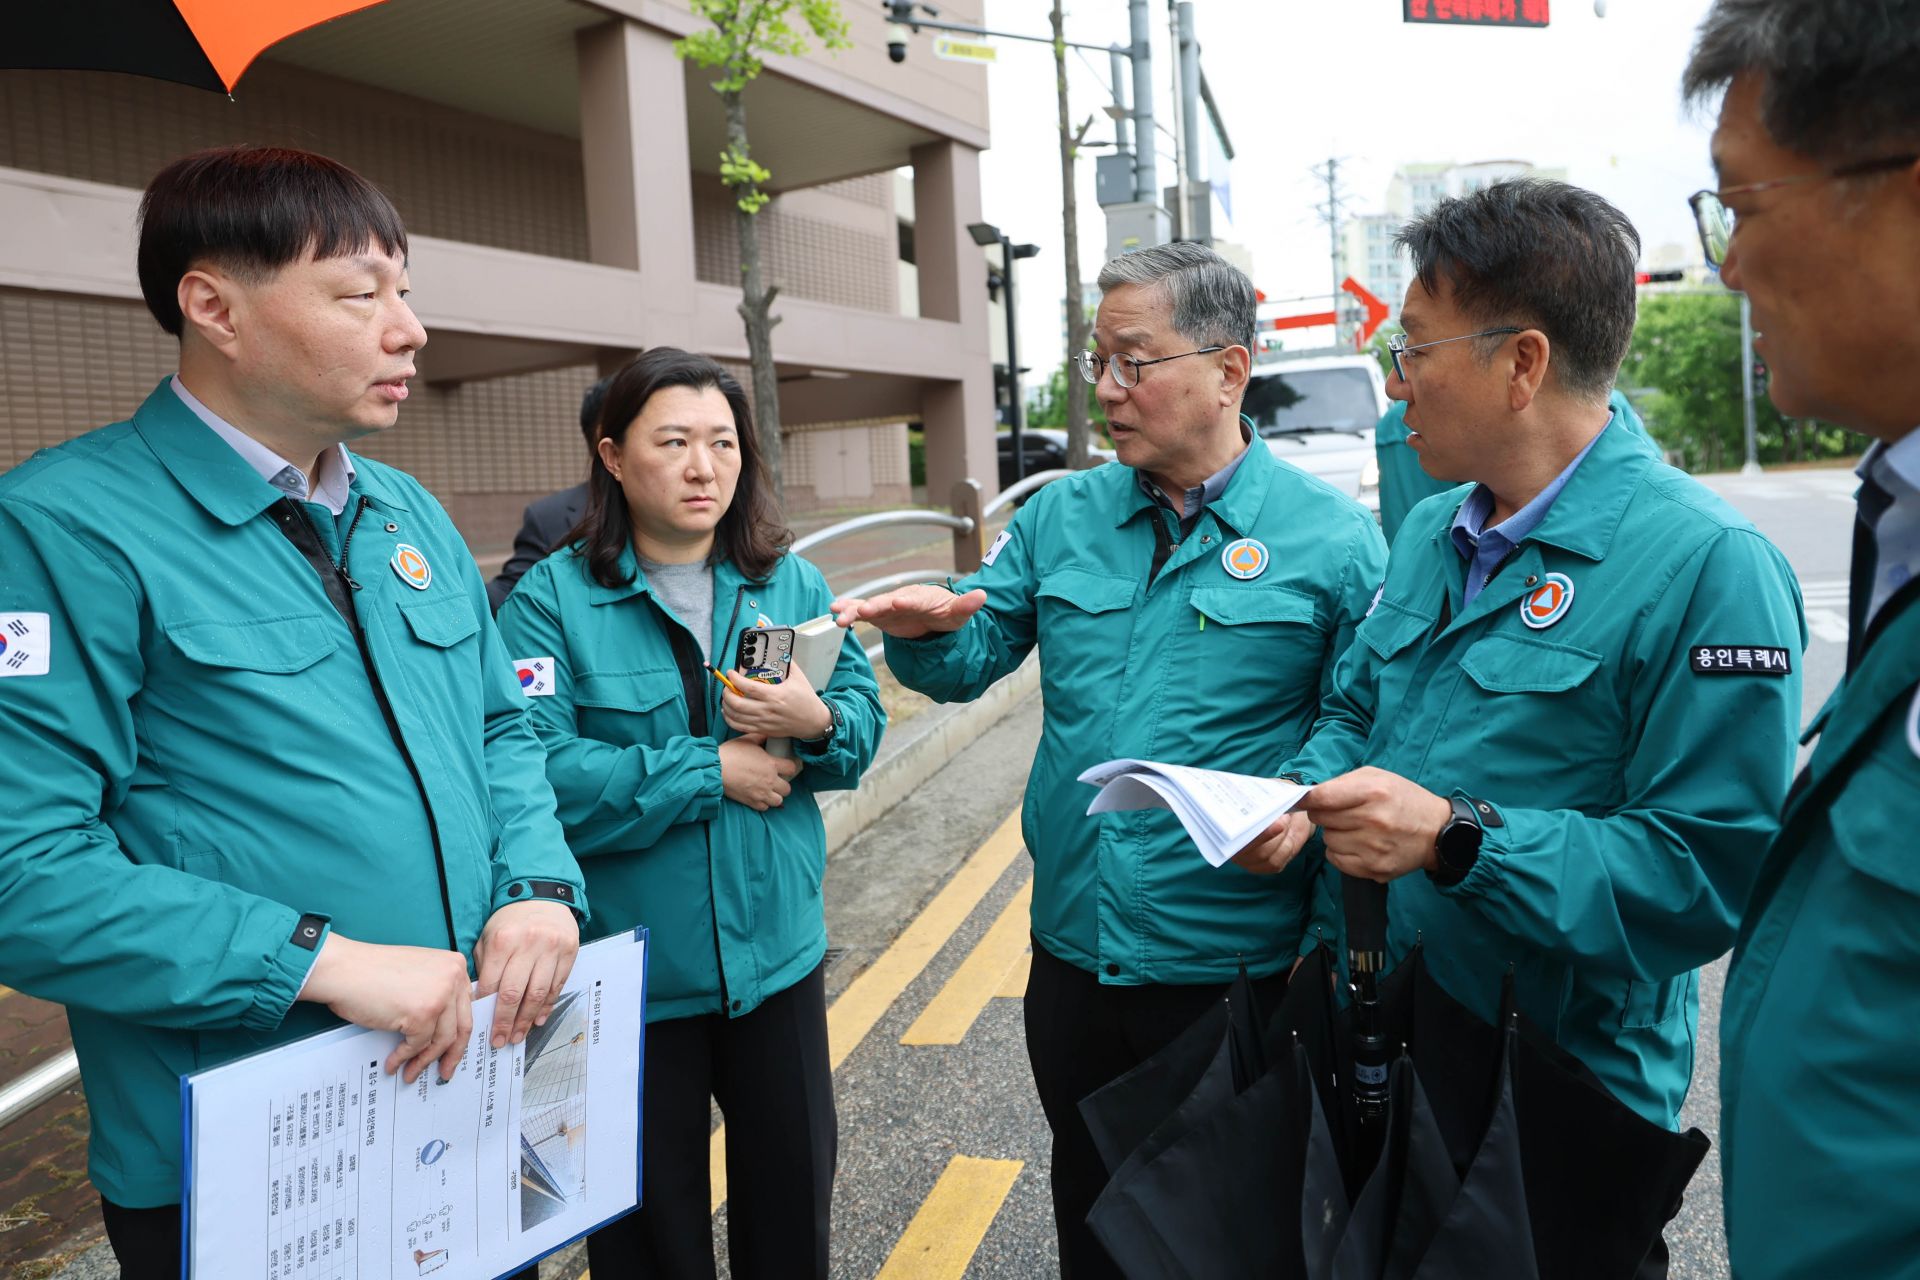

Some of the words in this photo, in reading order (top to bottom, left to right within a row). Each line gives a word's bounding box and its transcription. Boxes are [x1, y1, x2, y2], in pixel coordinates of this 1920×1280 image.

[1696, 648, 1787, 670] 용인특례시
[369, 1071, 377, 1087] 침수
[368, 1089, 376, 1105] 대비
[486, 1090, 495, 1112] 시스템
[366, 1108, 376, 1146] 비상연락망
[485, 1114, 493, 1127] 개요
